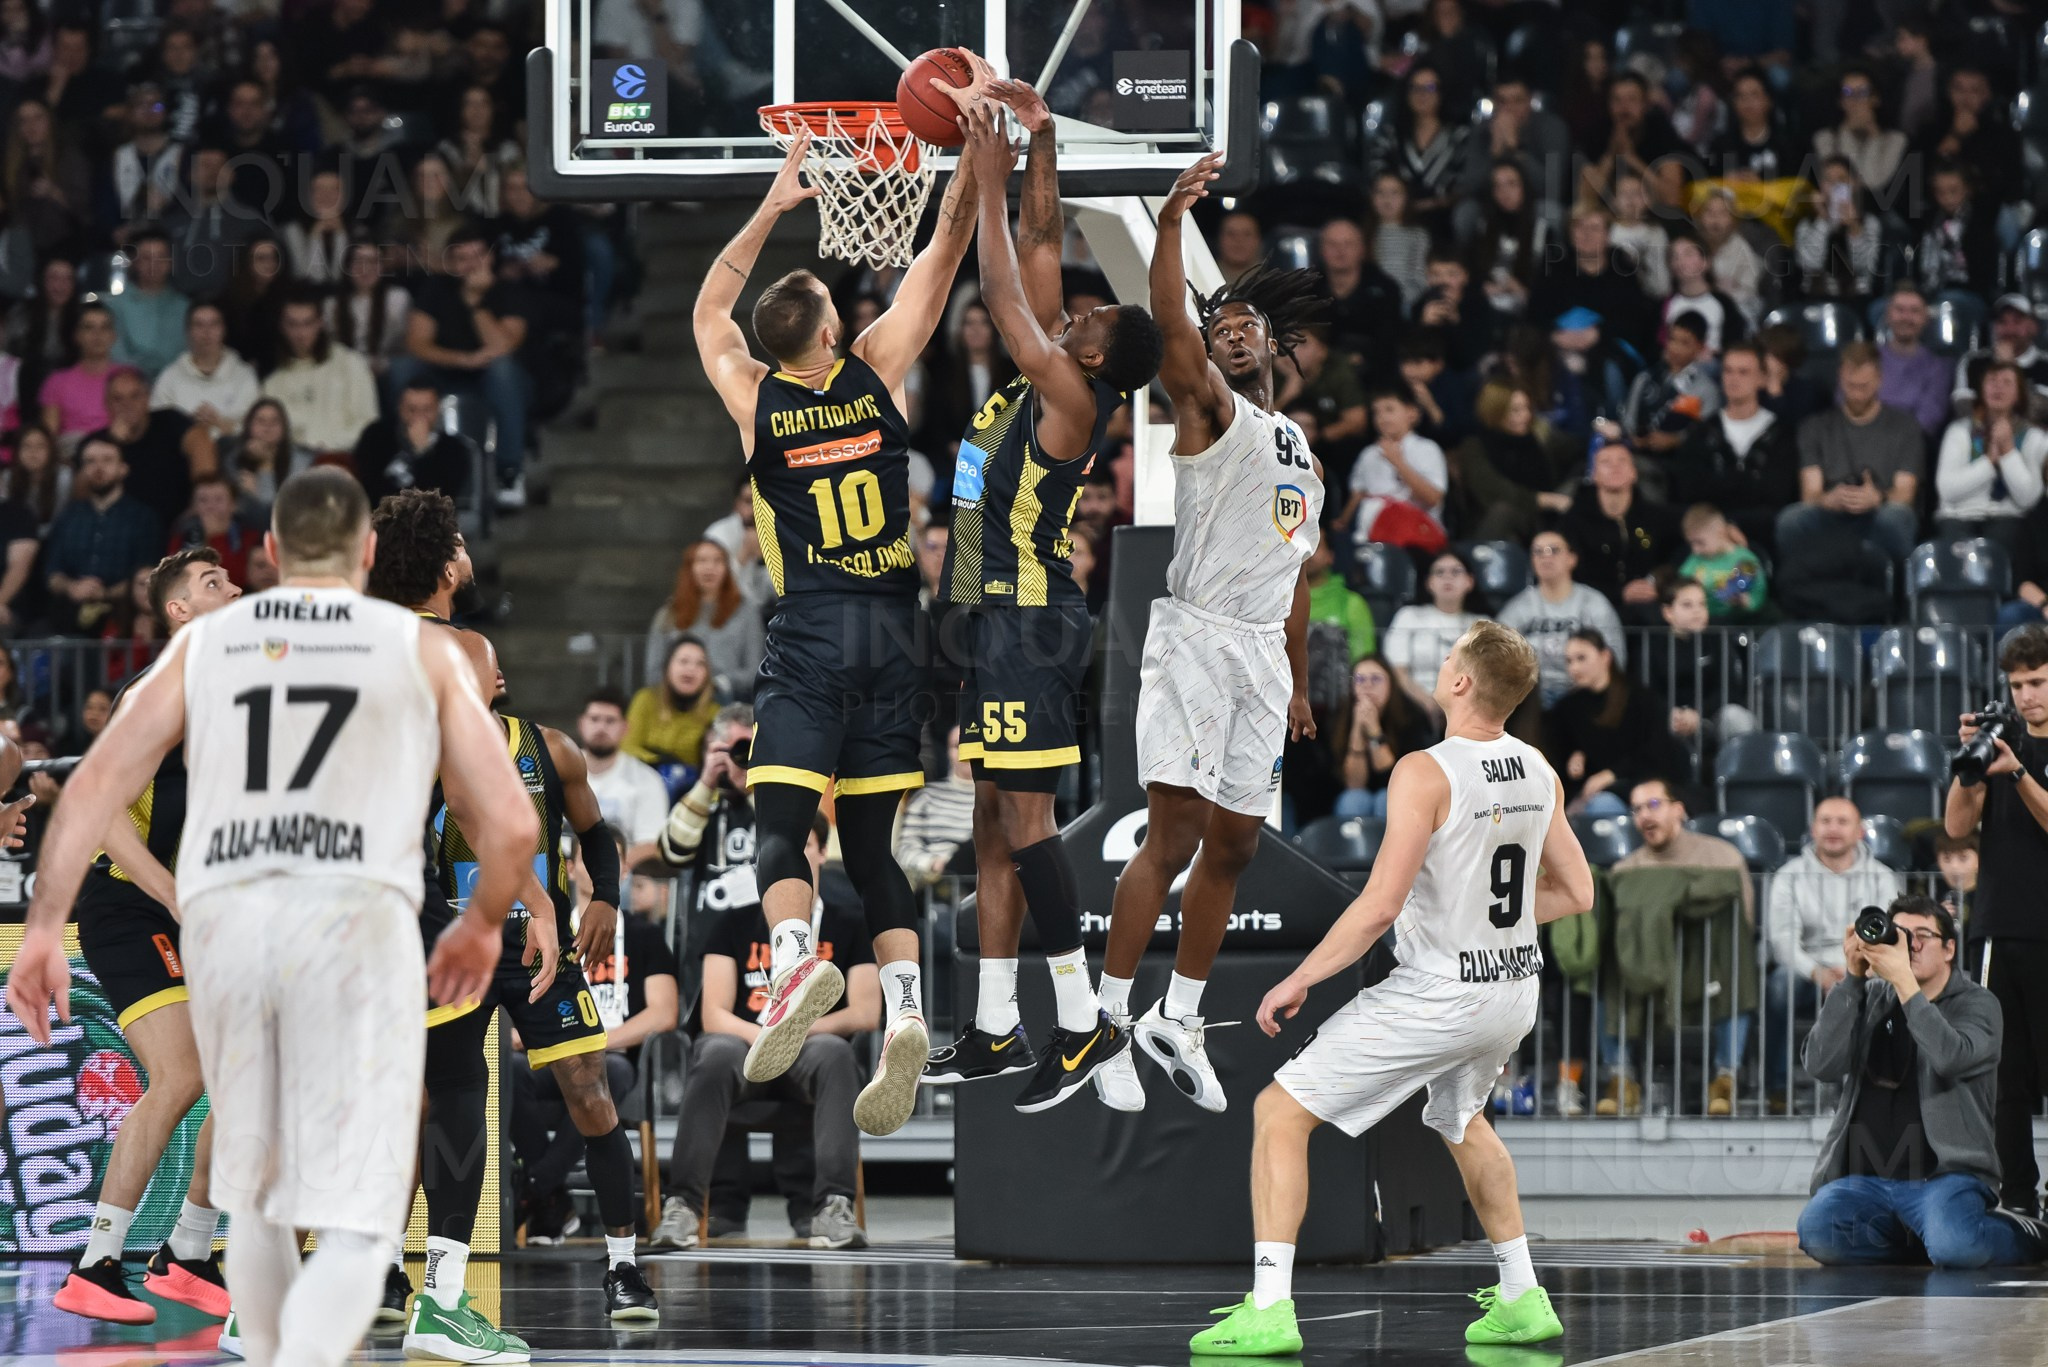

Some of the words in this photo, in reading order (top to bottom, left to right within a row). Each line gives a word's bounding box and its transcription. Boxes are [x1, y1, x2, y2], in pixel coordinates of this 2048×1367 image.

[1134, 84, 1187, 94] oneteam
[609, 105, 651, 117] BKT
[604, 121, 656, 134] EuroCup
[770, 394, 882, 438] CHATZIDAKIS
[787, 437, 880, 465] betsson
[807, 469, 886, 549] 10
[957, 500, 977, 510] GROUP
[1280, 498, 1301, 519] BT
[254, 600, 351, 621] ORELIK
[983, 701, 1027, 743] 55
[234, 684, 360, 792] 17
[1482, 756, 1527, 783] SALIN
[1489, 843, 1526, 929] 9
[1056, 964, 1077, 976] 55
[577, 990, 599, 1027] 0
[94, 1216, 112, 1232] 12
